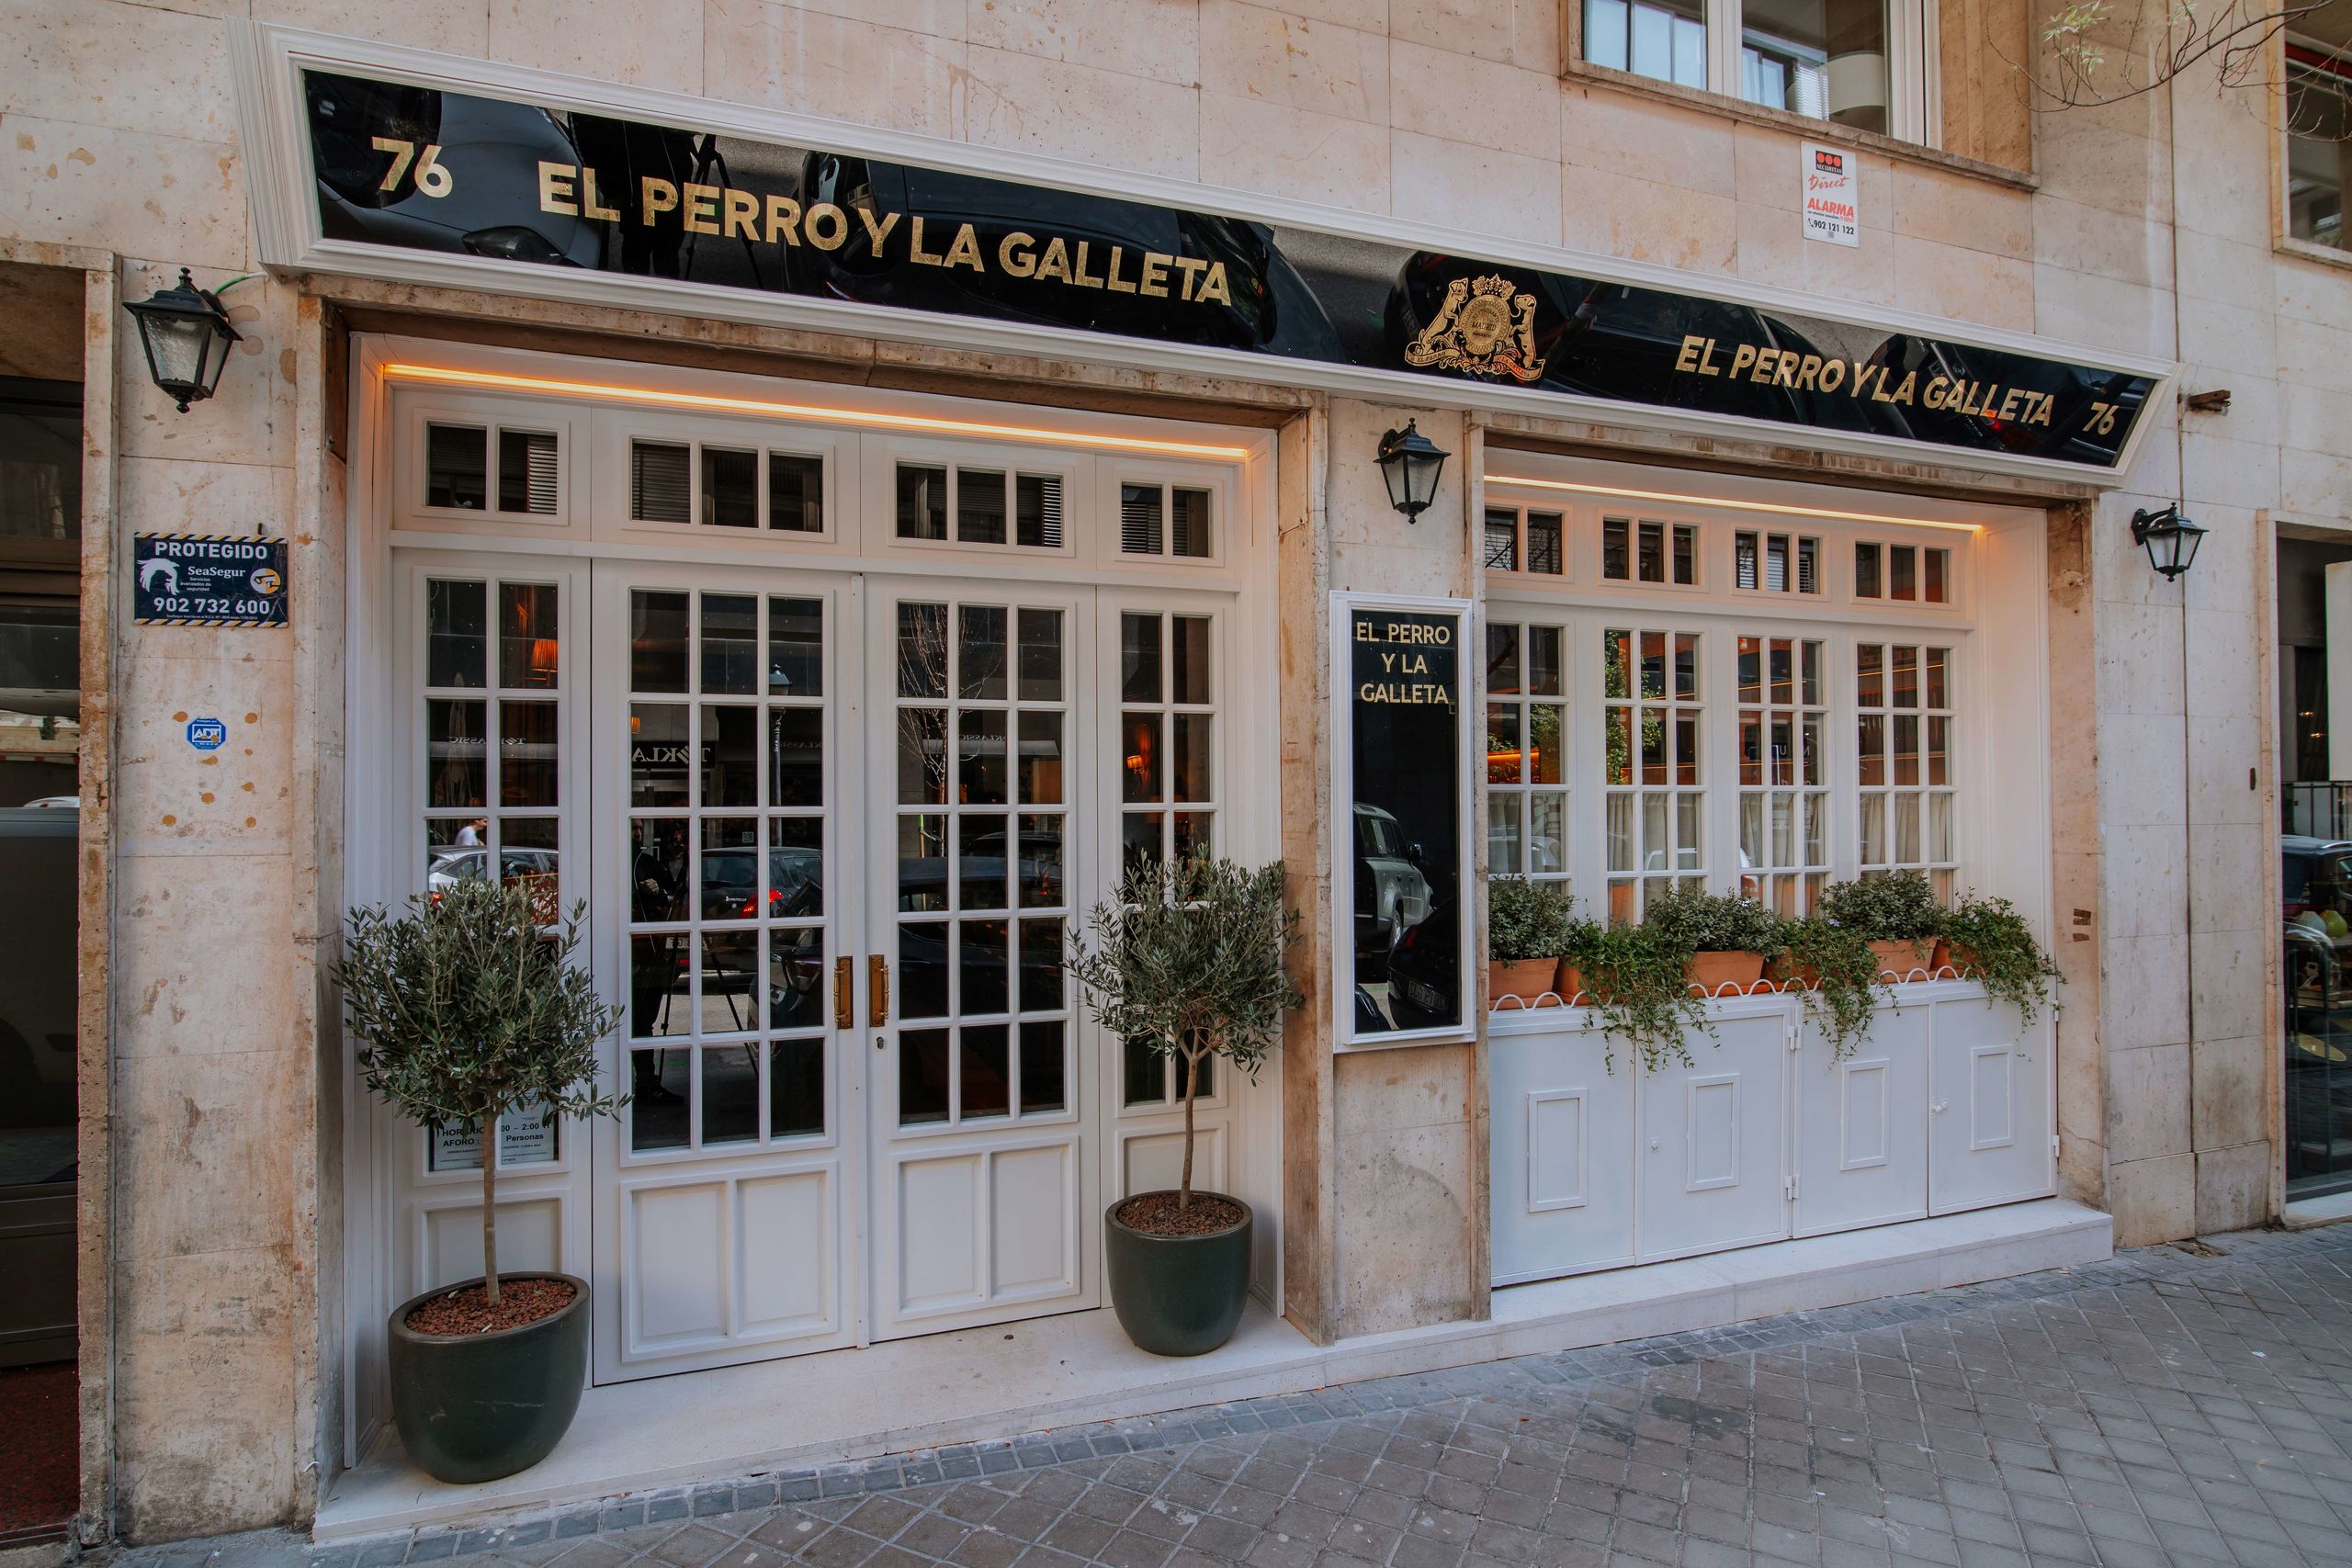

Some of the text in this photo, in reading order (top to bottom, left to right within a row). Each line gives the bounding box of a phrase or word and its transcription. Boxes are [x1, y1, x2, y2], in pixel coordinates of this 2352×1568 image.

[371, 136, 453, 198] 76
[1808, 174, 1850, 191] Direct
[1807, 197, 1854, 218] ALARMA
[538, 161, 1231, 306] EL PERRO Y LA GALLETA
[1814, 220, 1826, 230] 902
[1828, 222, 1839, 232] 121
[1843, 225, 1854, 235] 122
[1675, 335, 1720, 376] EL
[1729, 344, 1846, 393] PERRO
[1850, 363, 1878, 398] Y
[1871, 367, 1917, 406] LA
[1922, 377, 2054, 426] GALLETA
[2082, 402, 2120, 435] 76
[154, 541, 267, 559] PROTEGIDO
[187, 566, 246, 579] SeaSegur
[153, 597, 270, 615] 902 732 600
[1356, 622, 1451, 644] EL PERRO
[1381, 653, 1428, 674] Y LA
[1361, 683, 1449, 705] GALLETA
[194, 728, 220, 739] ADT
[522, 1122, 539, 1131] 2:00
[443, 1138, 475, 1147] AFORO
[506, 1134, 544, 1142] Personas
